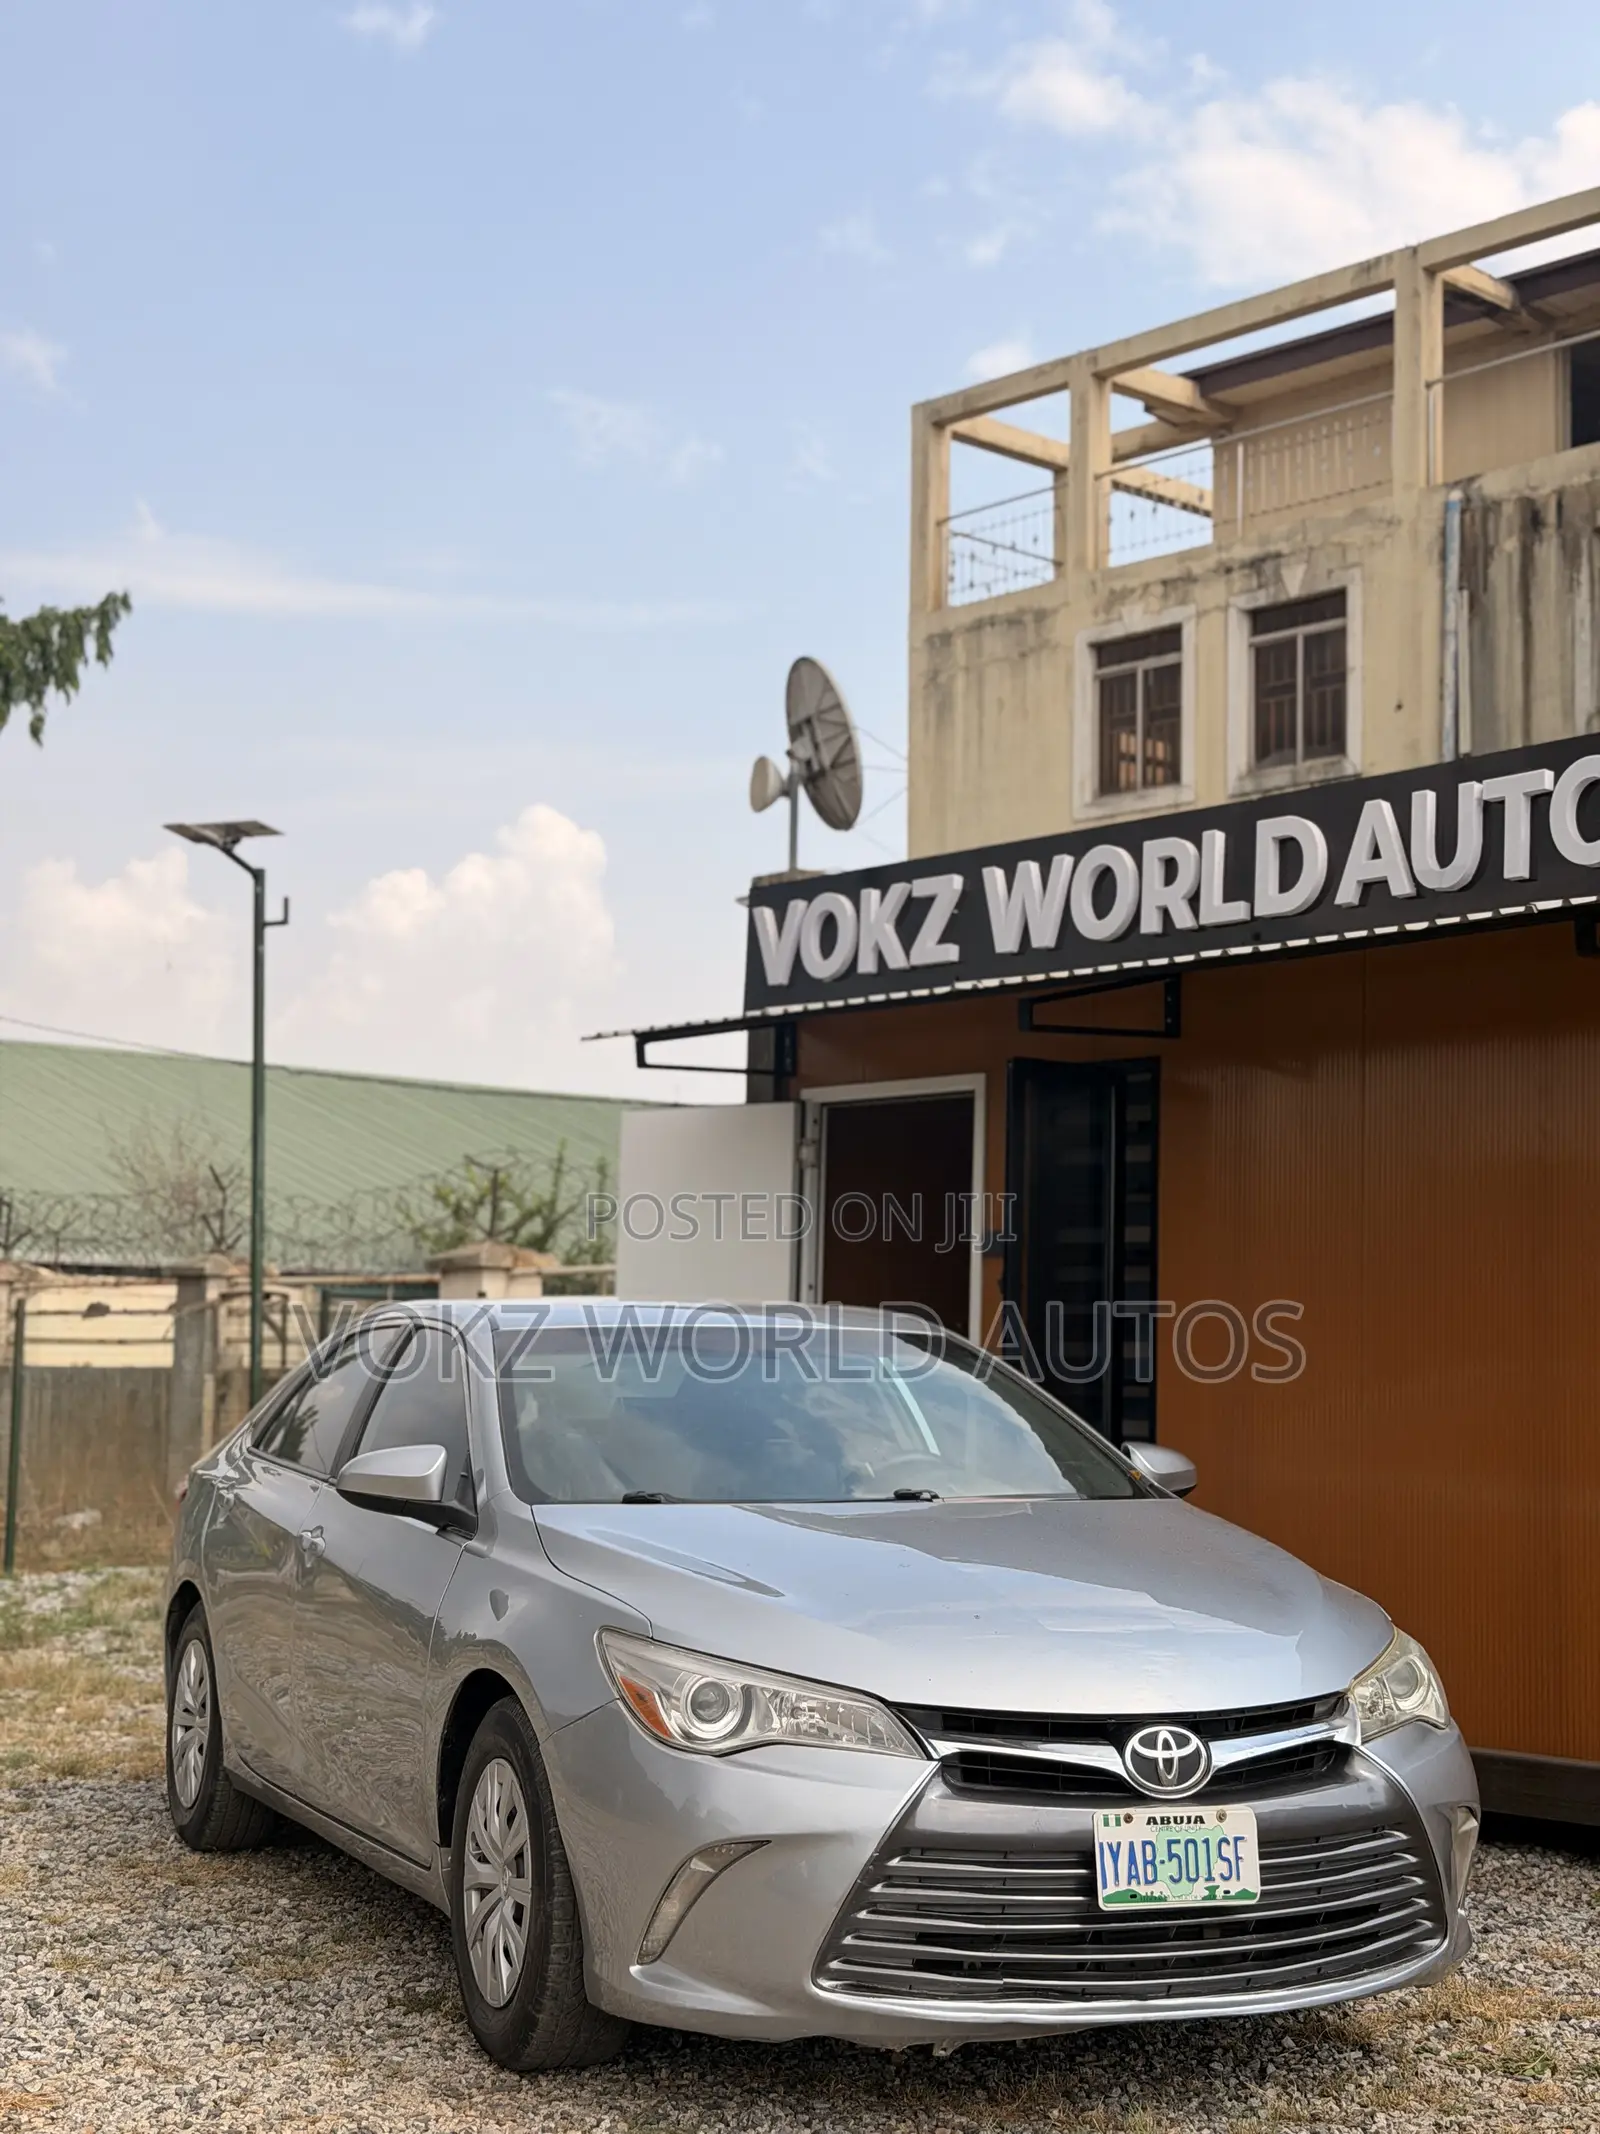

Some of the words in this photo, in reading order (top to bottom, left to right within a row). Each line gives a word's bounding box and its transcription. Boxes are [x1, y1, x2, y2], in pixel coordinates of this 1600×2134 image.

[752, 873, 964, 986] VOKZ
[982, 815, 1328, 954] WORLD
[1145, 1815, 1206, 1826] ABUJA
